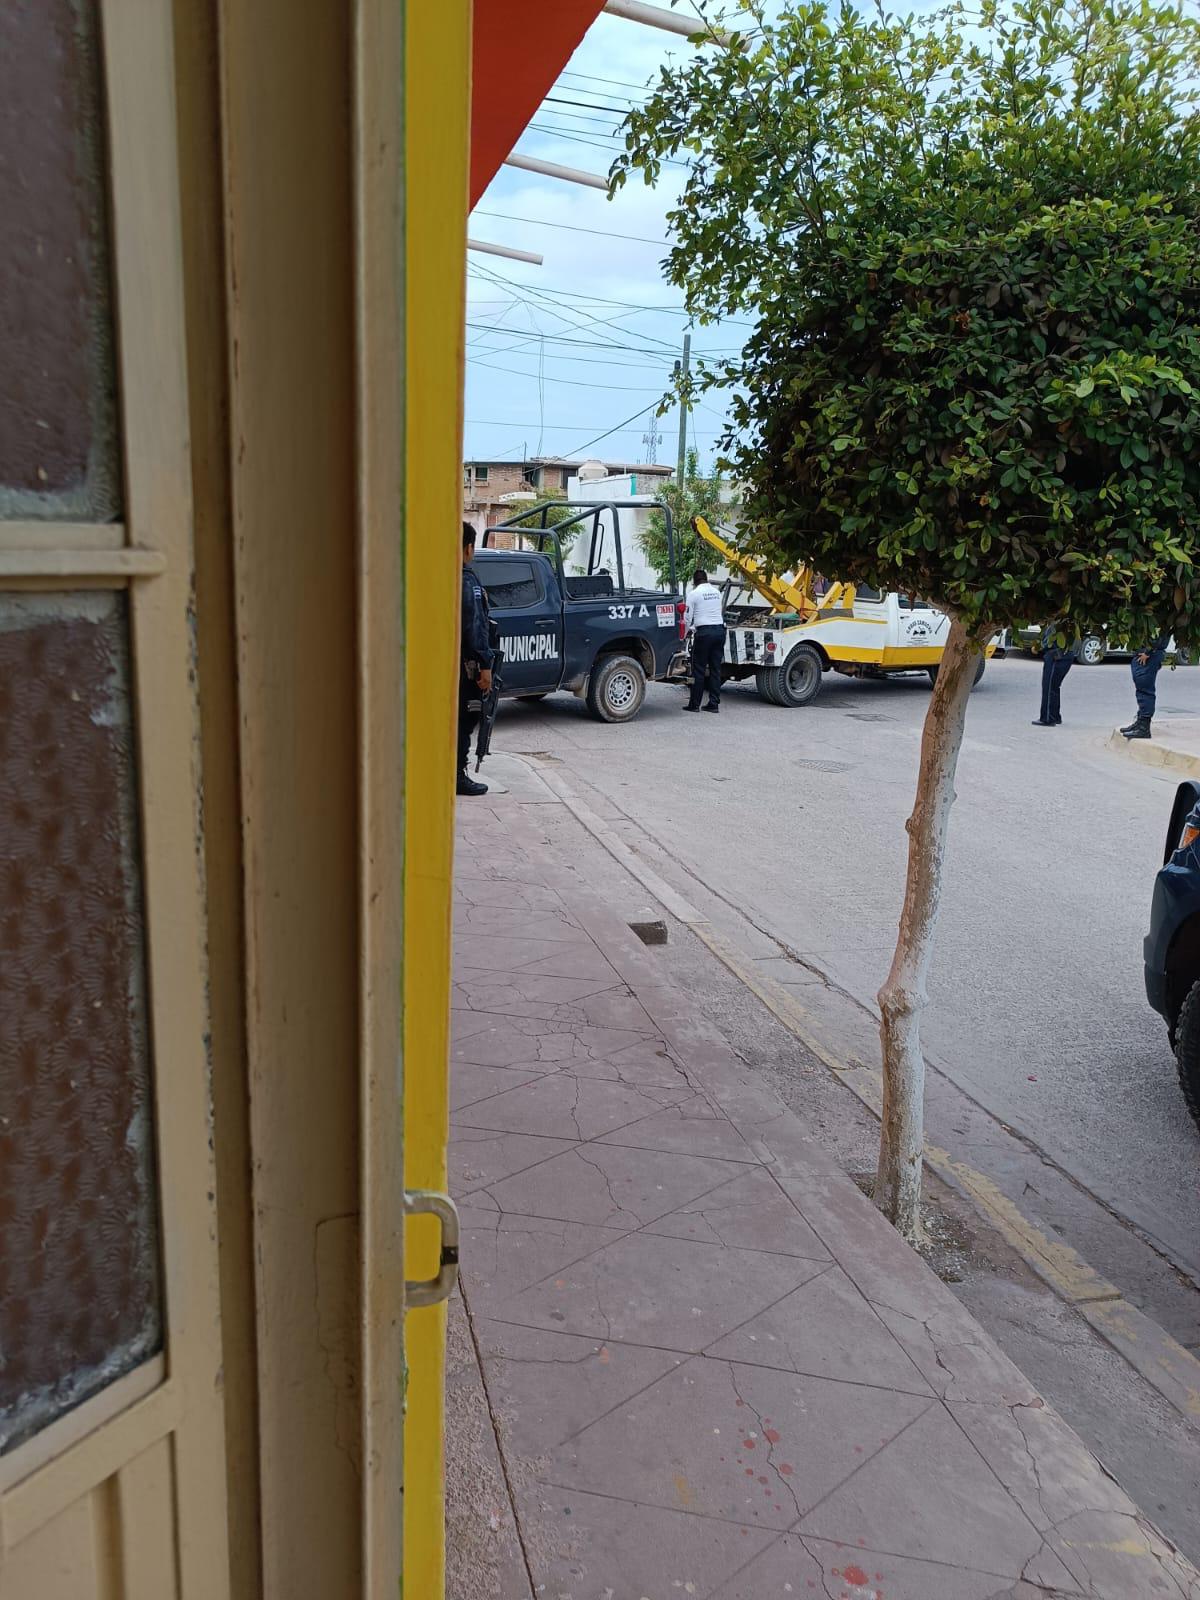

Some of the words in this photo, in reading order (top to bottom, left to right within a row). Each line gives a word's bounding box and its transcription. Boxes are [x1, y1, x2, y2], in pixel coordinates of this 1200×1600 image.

[608, 604, 634, 620] 337
[638, 604, 650, 618] A
[499, 633, 559, 663] MUNICIPAL
